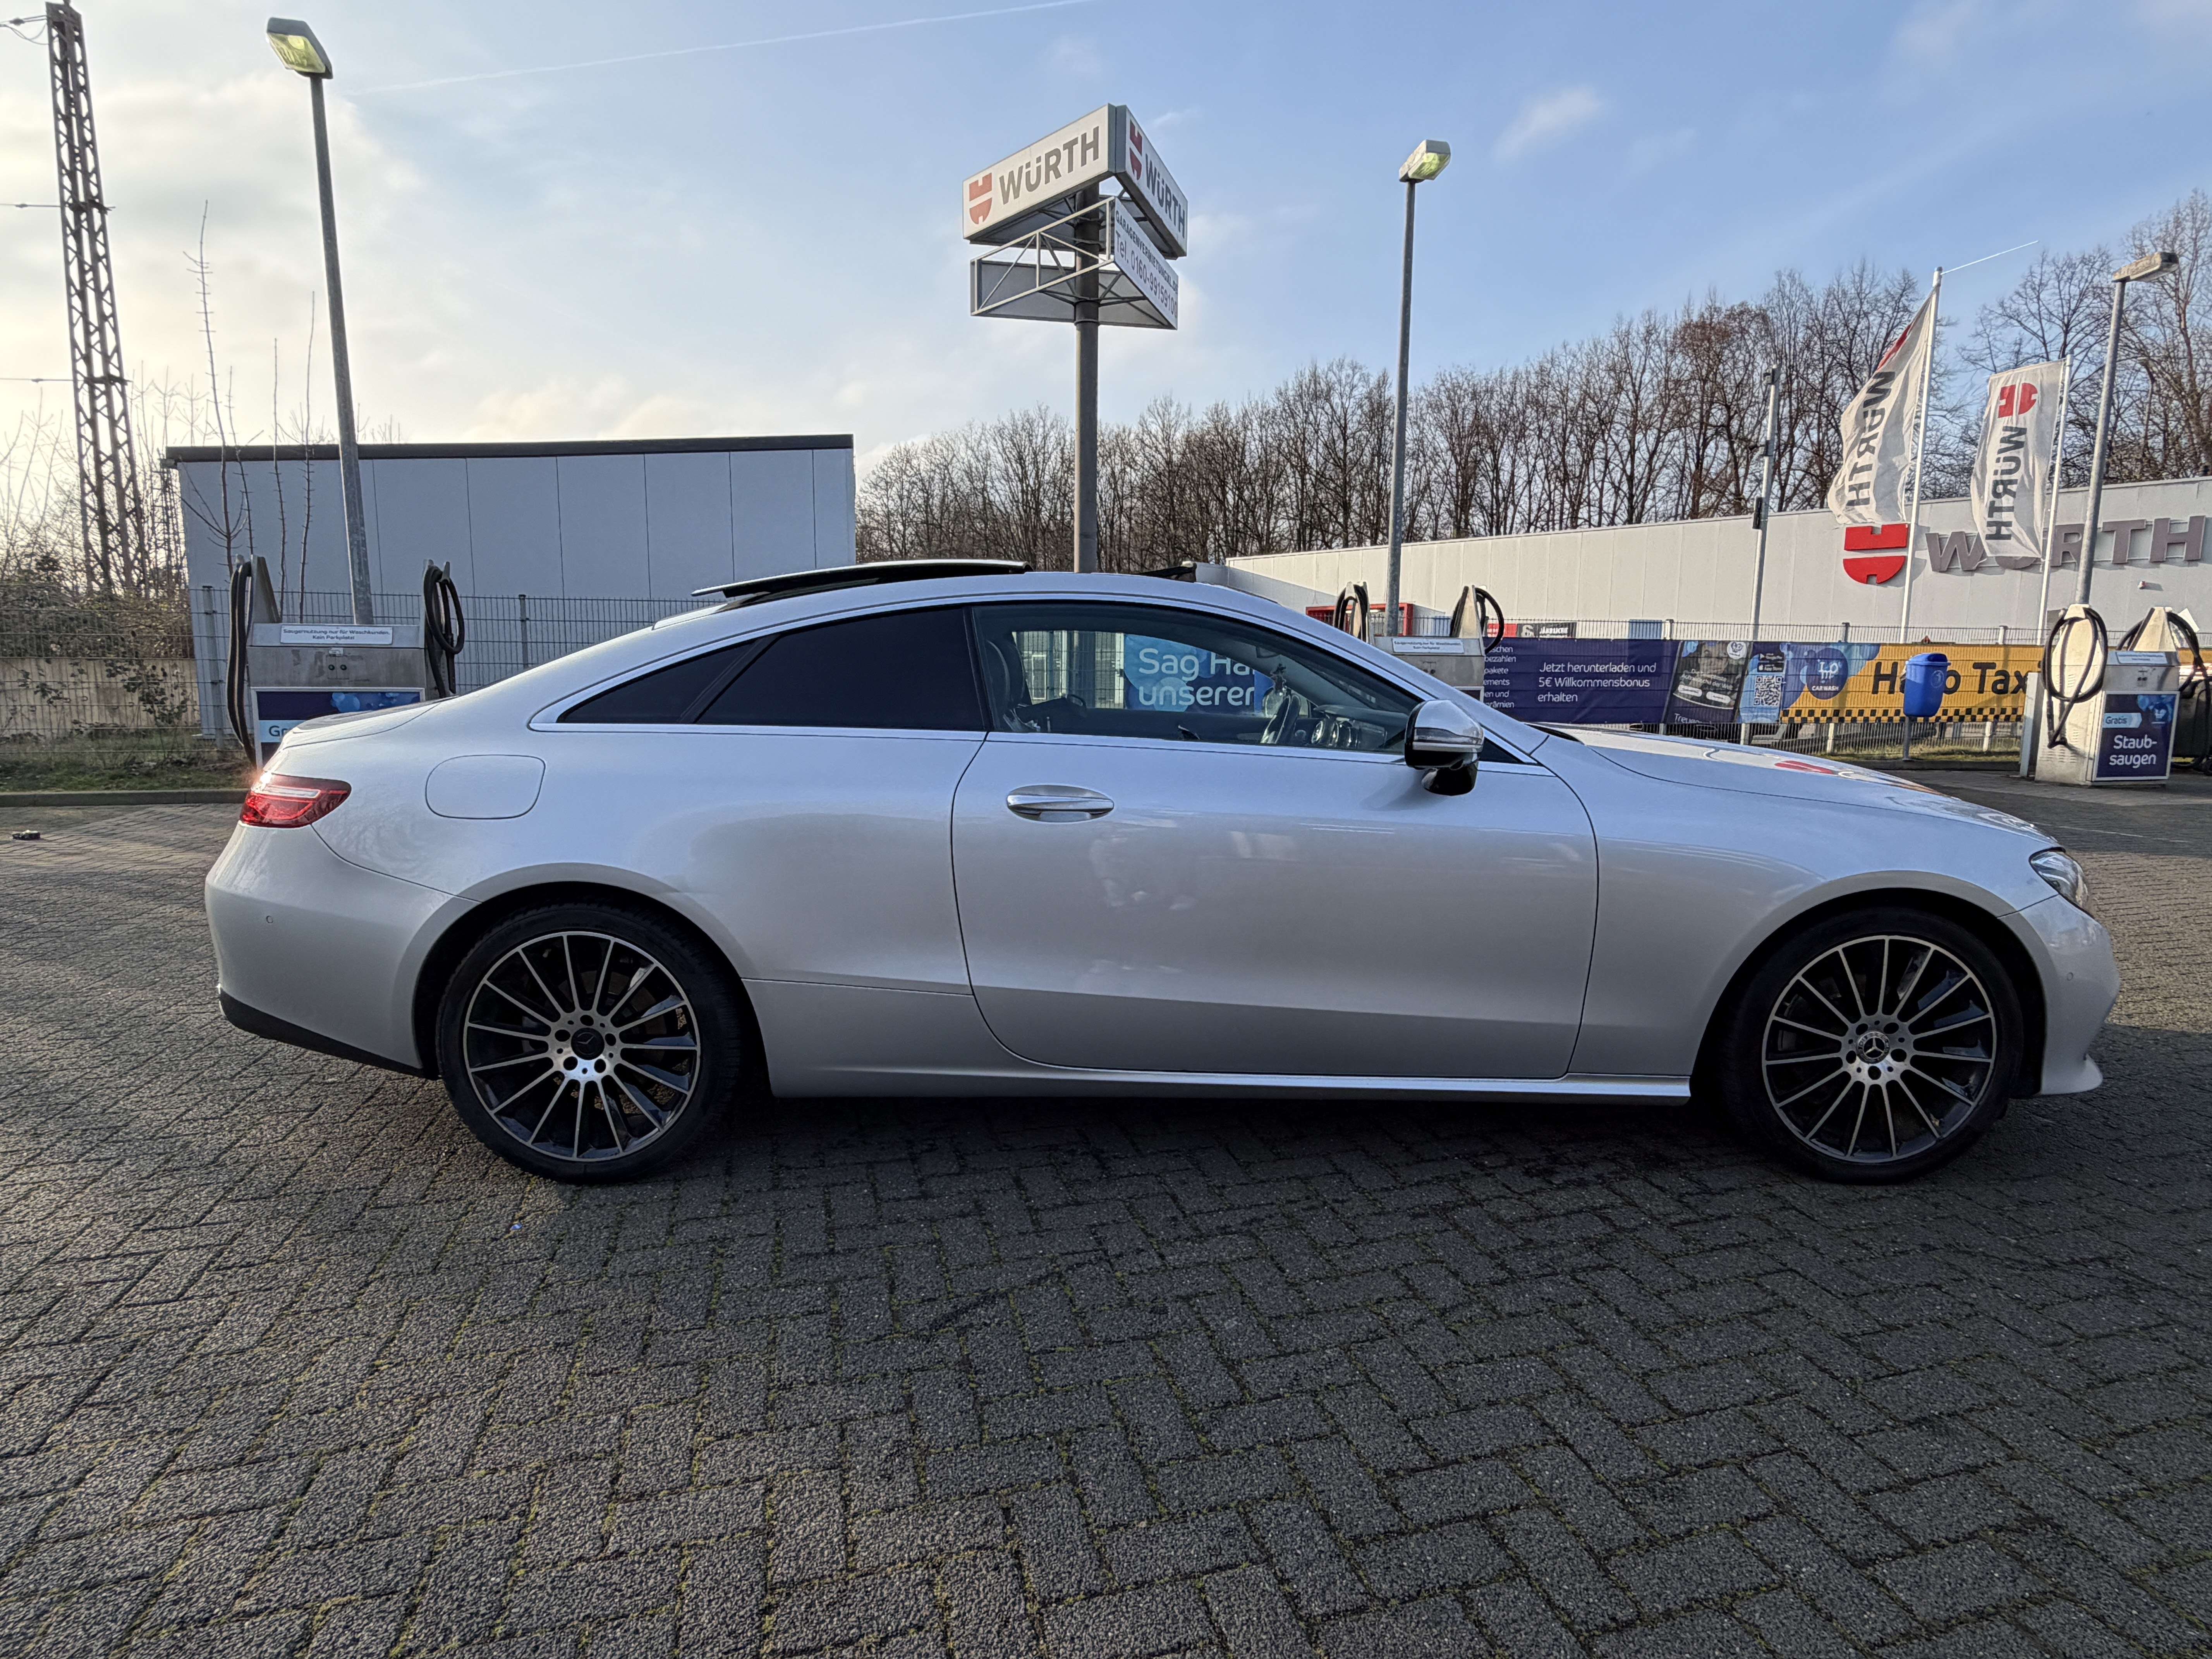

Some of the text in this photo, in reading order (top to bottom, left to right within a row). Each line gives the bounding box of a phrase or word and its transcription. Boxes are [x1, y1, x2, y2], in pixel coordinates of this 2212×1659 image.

[999, 126, 1099, 205] WÜRTH
[1145, 153, 1185, 238] WÜRTH
[1116, 230, 1128, 264] Tel.
[1139, 648, 1254, 682] Sag Ha
[1539, 661, 1656, 672] Jetzt herunterladen und
[1539, 677, 1650, 687] 5€ Willkommensbonus
[1973, 662, 2042, 694] Tax
[1537, 692, 1578, 702] erhalten
[2105, 716, 2127, 724] Gratis
[2113, 734, 2157, 749] Staub-
[2109, 754, 2157, 768] saugen
